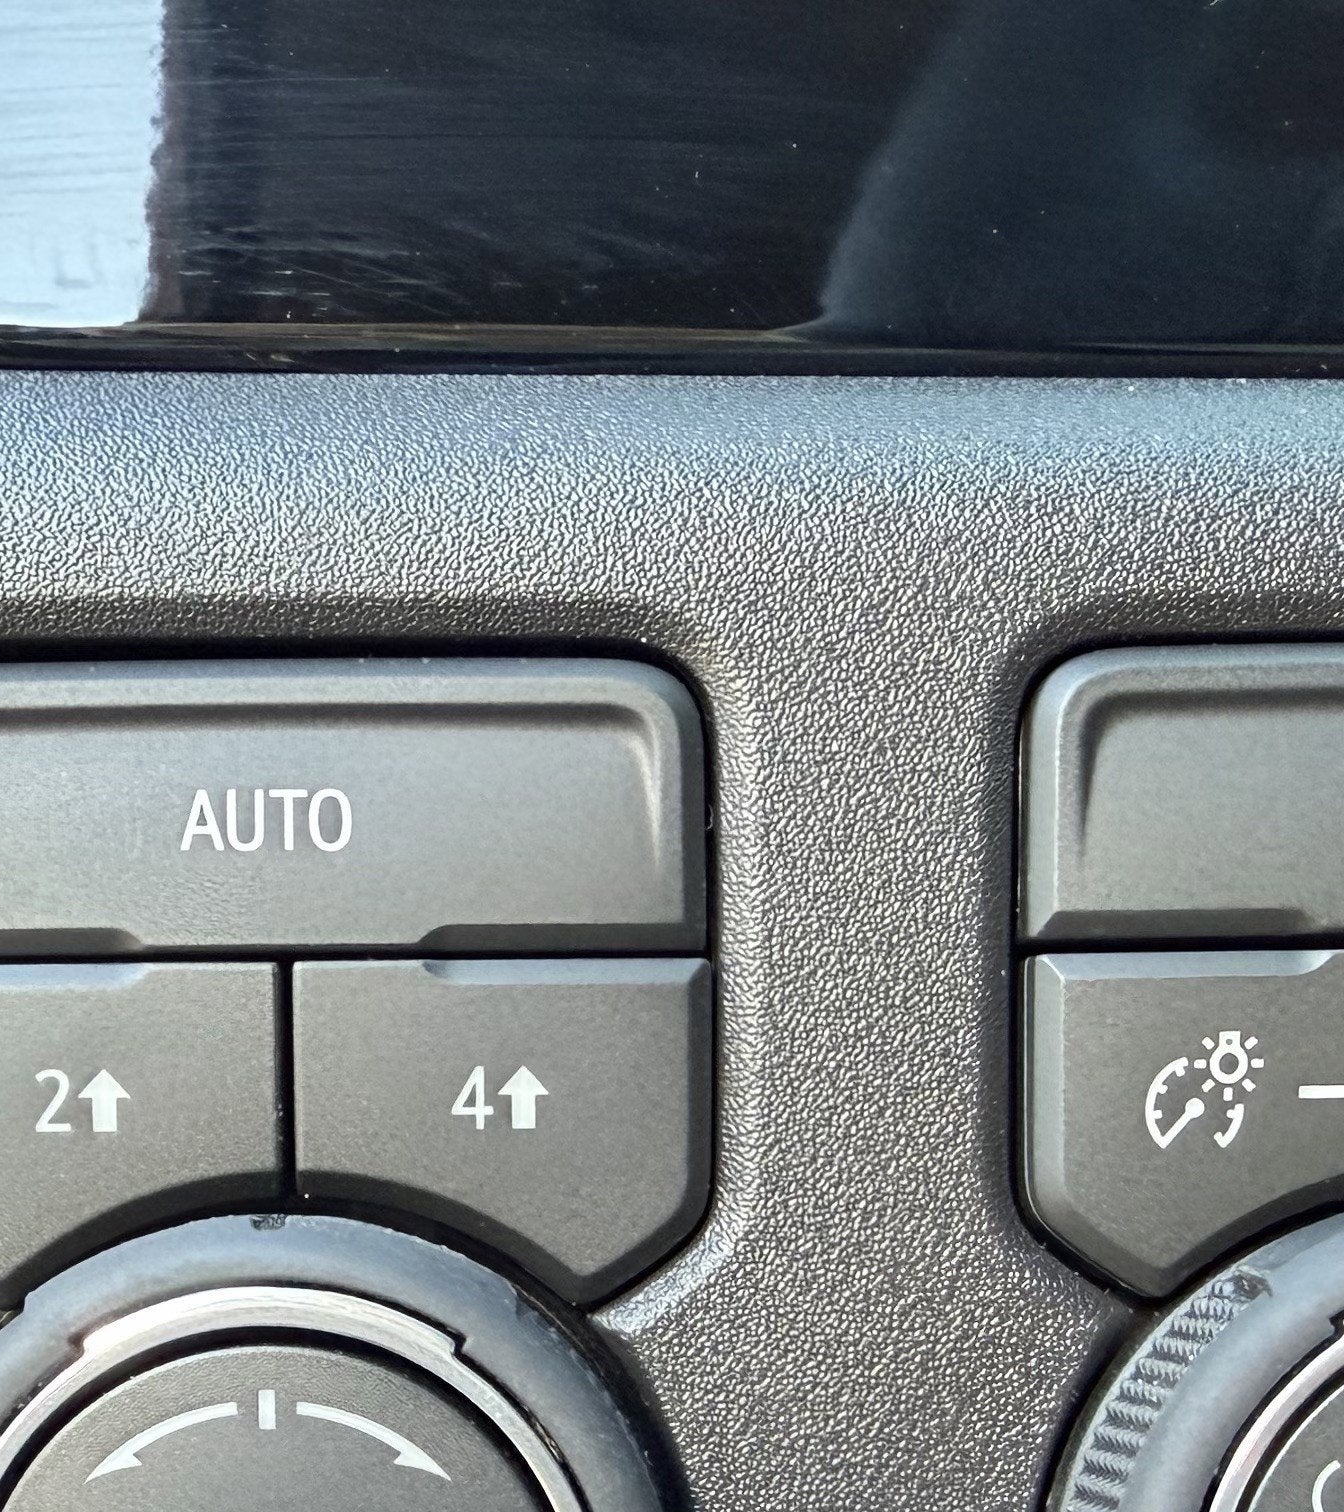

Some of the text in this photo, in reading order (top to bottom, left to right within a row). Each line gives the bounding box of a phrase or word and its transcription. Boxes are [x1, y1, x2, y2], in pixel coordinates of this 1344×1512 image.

[179, 787, 354, 852] AUTO
[33, 1068, 73, 1133] 2
[450, 1064, 495, 1131] 4
